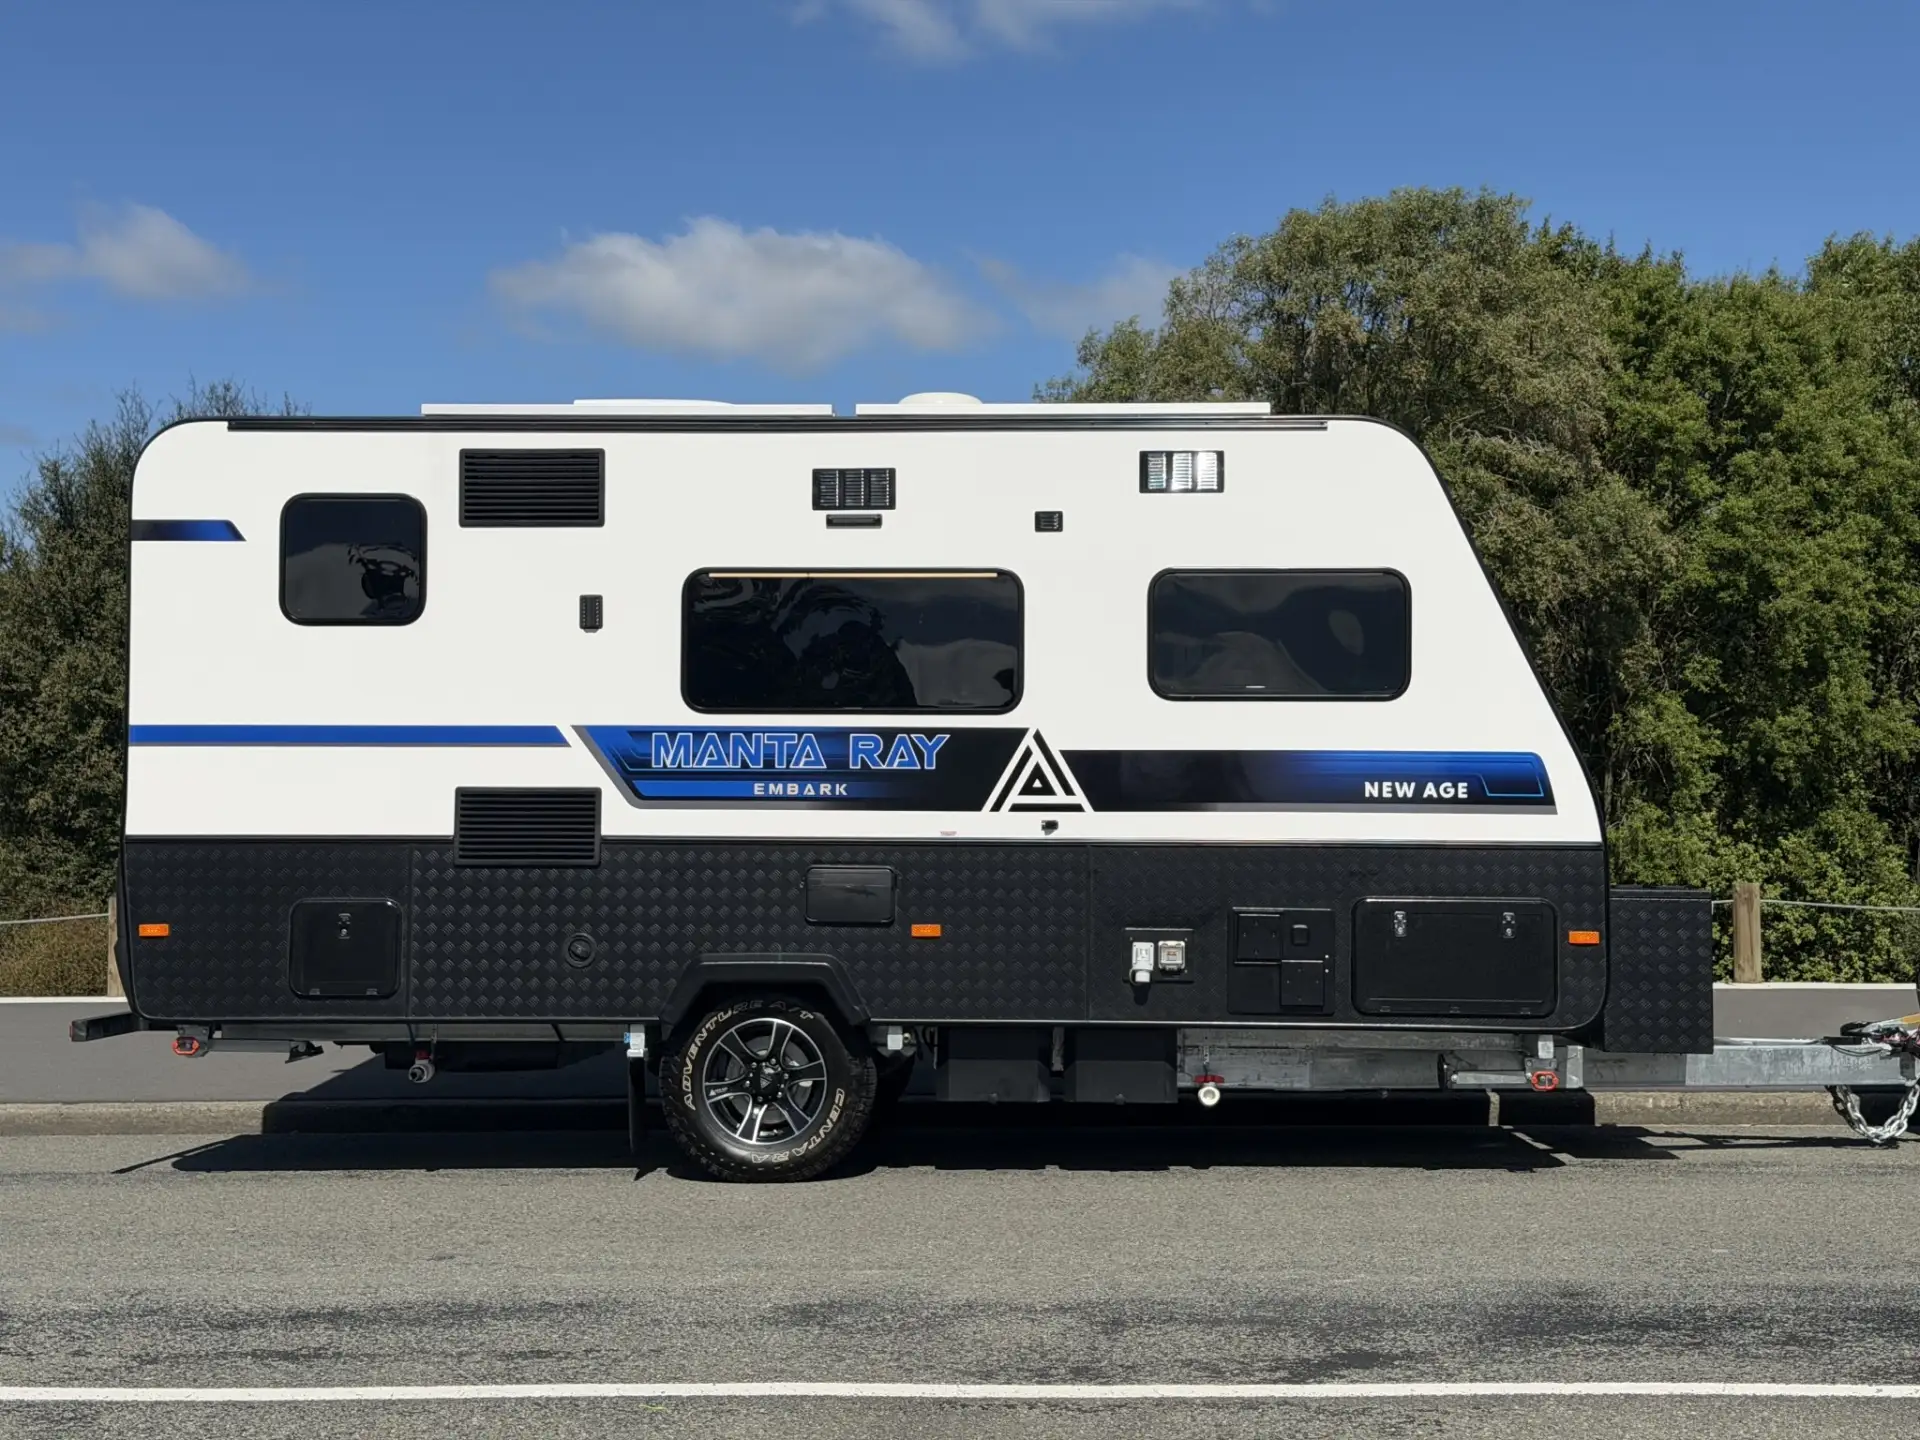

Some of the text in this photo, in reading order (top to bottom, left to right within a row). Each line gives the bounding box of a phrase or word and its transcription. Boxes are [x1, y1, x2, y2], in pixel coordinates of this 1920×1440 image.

[651, 732, 951, 770] MANTA RAY
[753, 782, 849, 797] EMBARK
[1364, 781, 1469, 799] NEW AGE
[751, 1088, 845, 1164] CENTARA
